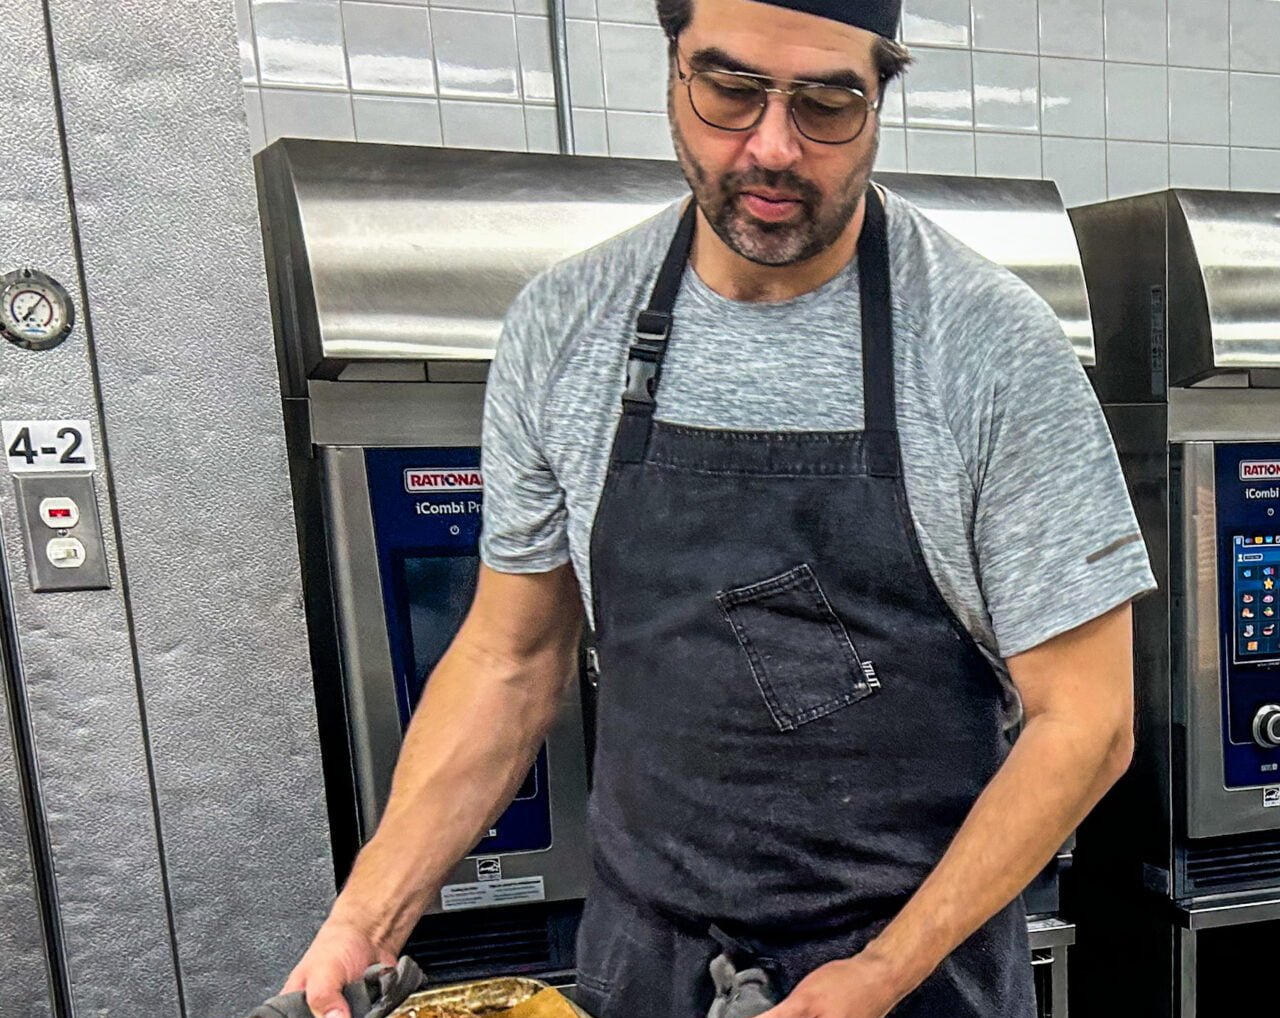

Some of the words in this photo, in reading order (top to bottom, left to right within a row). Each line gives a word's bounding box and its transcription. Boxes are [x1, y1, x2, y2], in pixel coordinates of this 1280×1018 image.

[9, 427, 86, 465] 4-2
[1245, 487, 1279, 499] iCombi
[416, 501, 465, 514] iCombi
[468, 501, 482, 513] Pr
